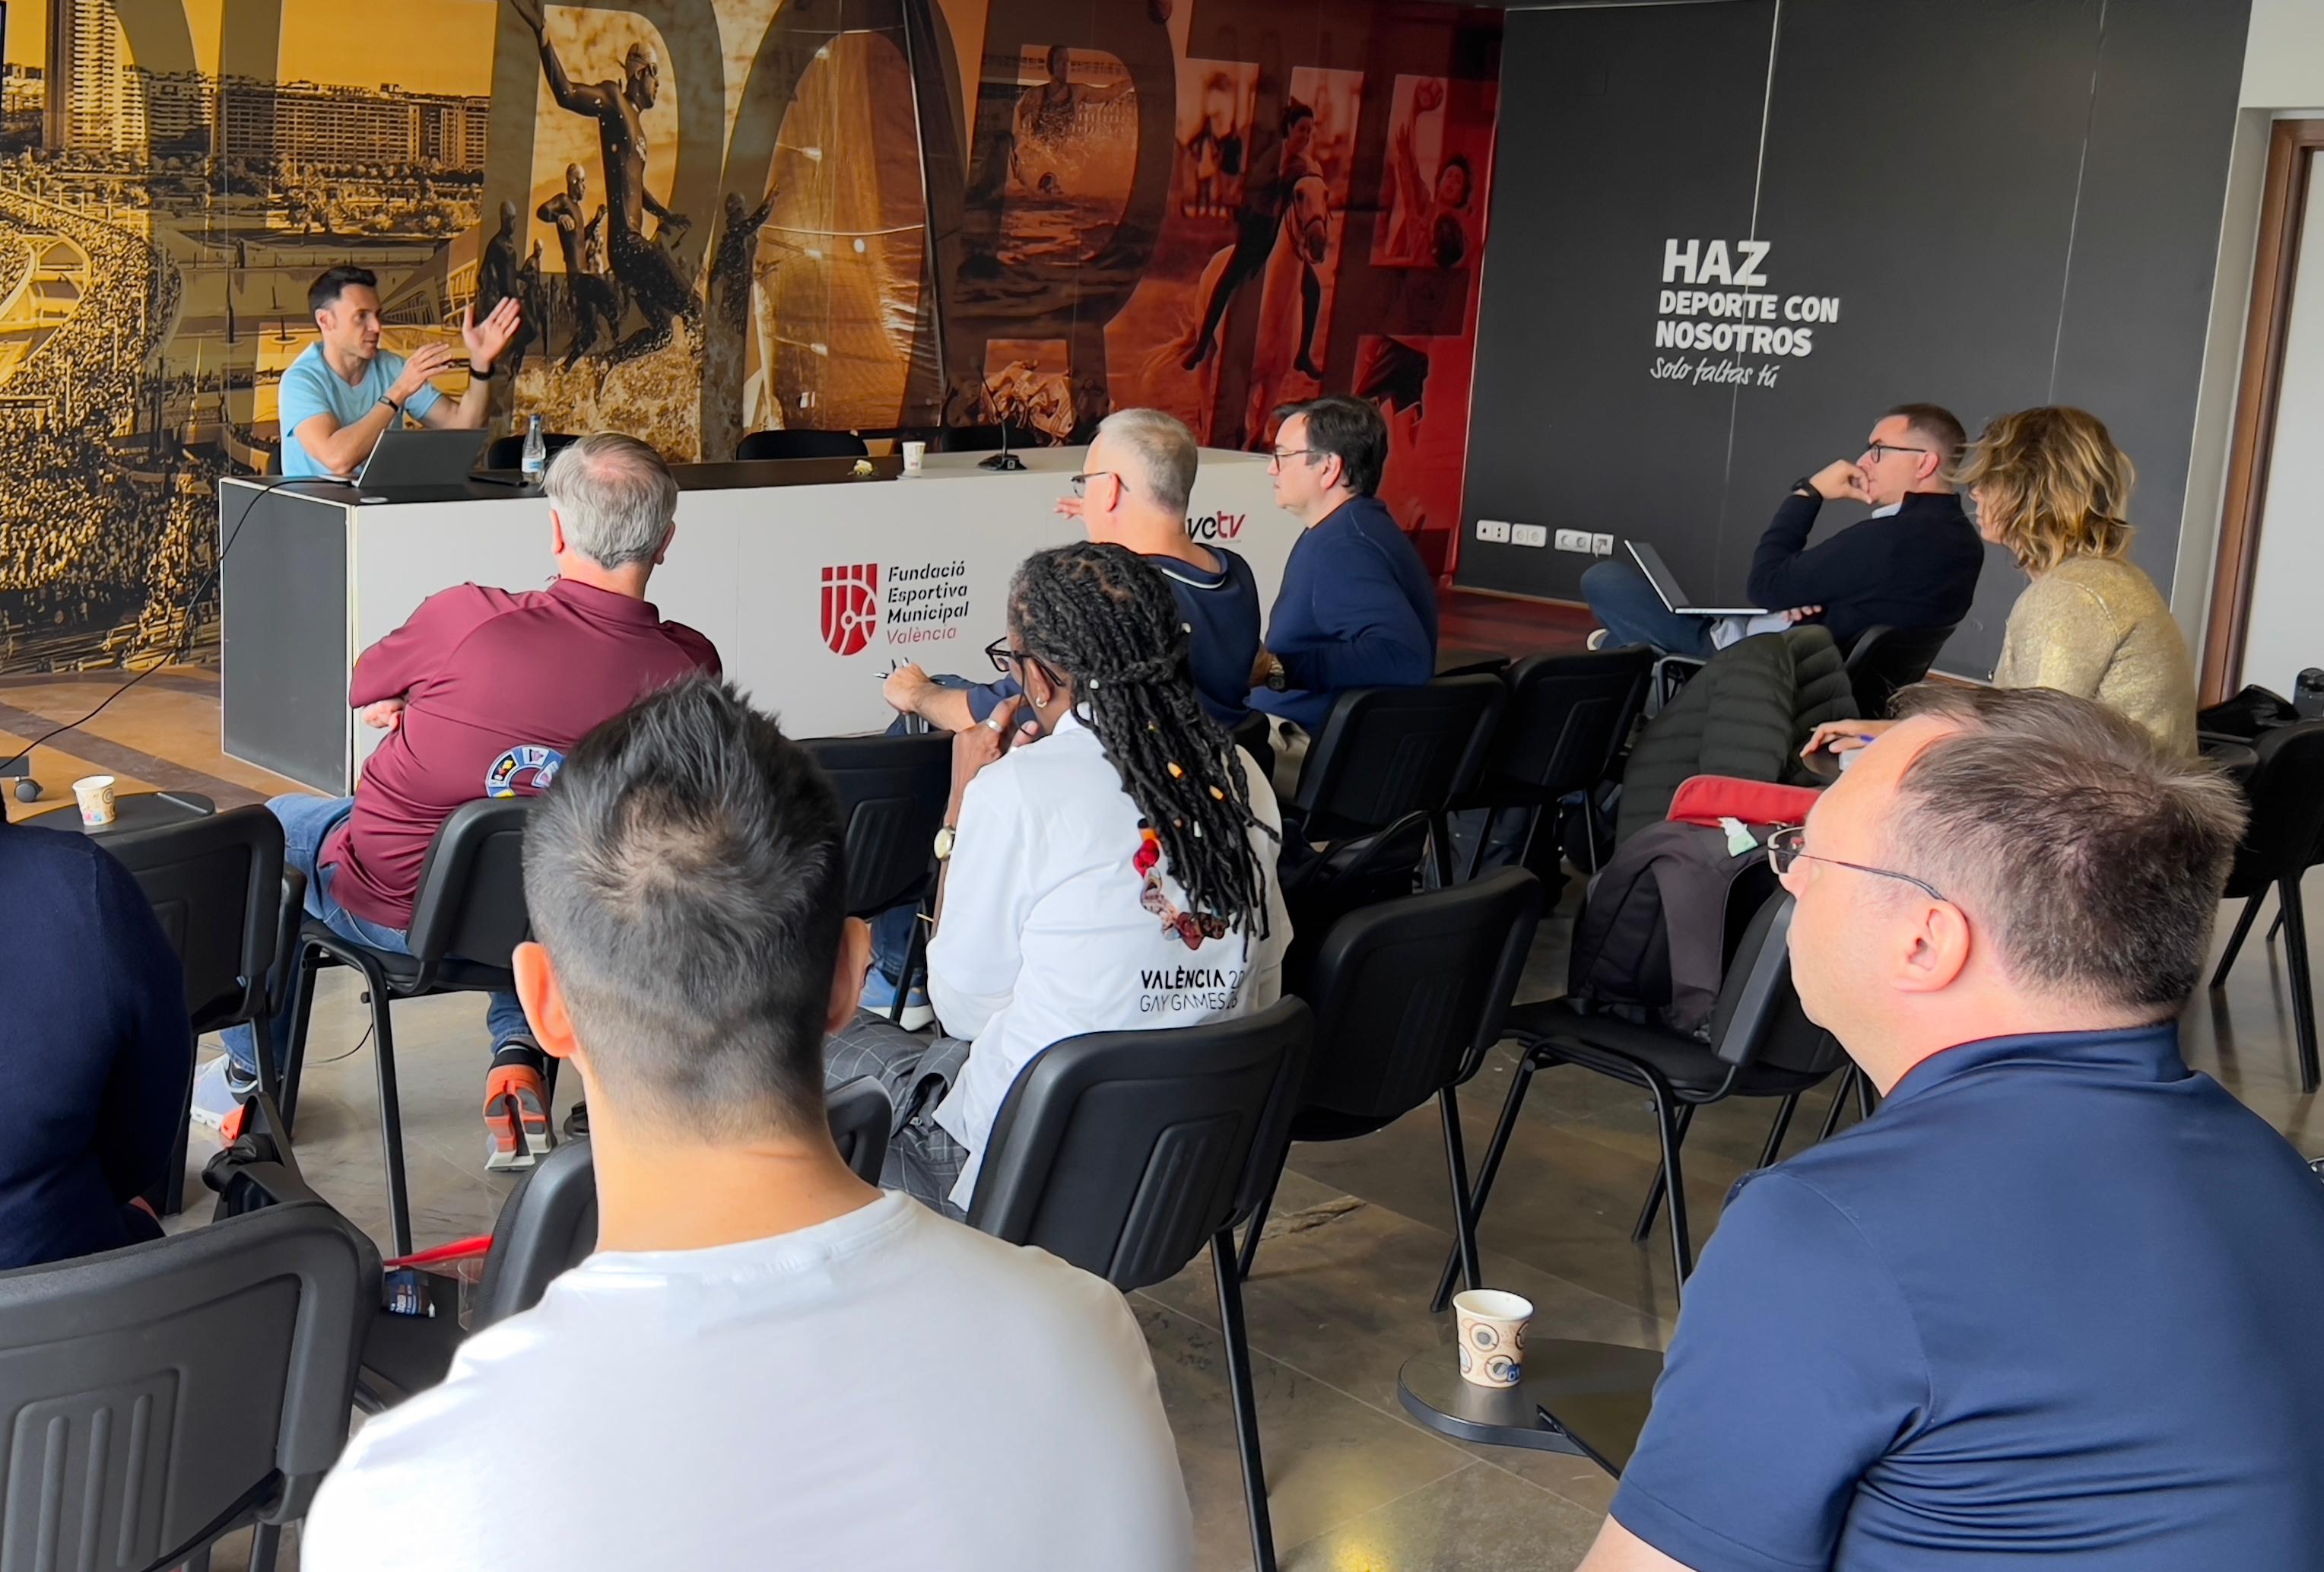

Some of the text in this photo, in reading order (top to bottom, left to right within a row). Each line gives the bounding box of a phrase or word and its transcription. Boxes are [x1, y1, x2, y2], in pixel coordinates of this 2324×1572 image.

[1662, 239, 1771, 287] HAZ
[1659, 290, 1840, 323] DEPORTE CON
[1655, 320, 1814, 357] NOSOTROS
[1692, 357, 1754, 386] faltas
[1757, 364, 1781, 389] tú
[888, 561, 966, 583] Fundació
[887, 582, 968, 606] Esportiva
[887, 601, 970, 624] Municipal
[887, 624, 957, 646] València
[1141, 964, 1226, 989] VALÈNCIA
